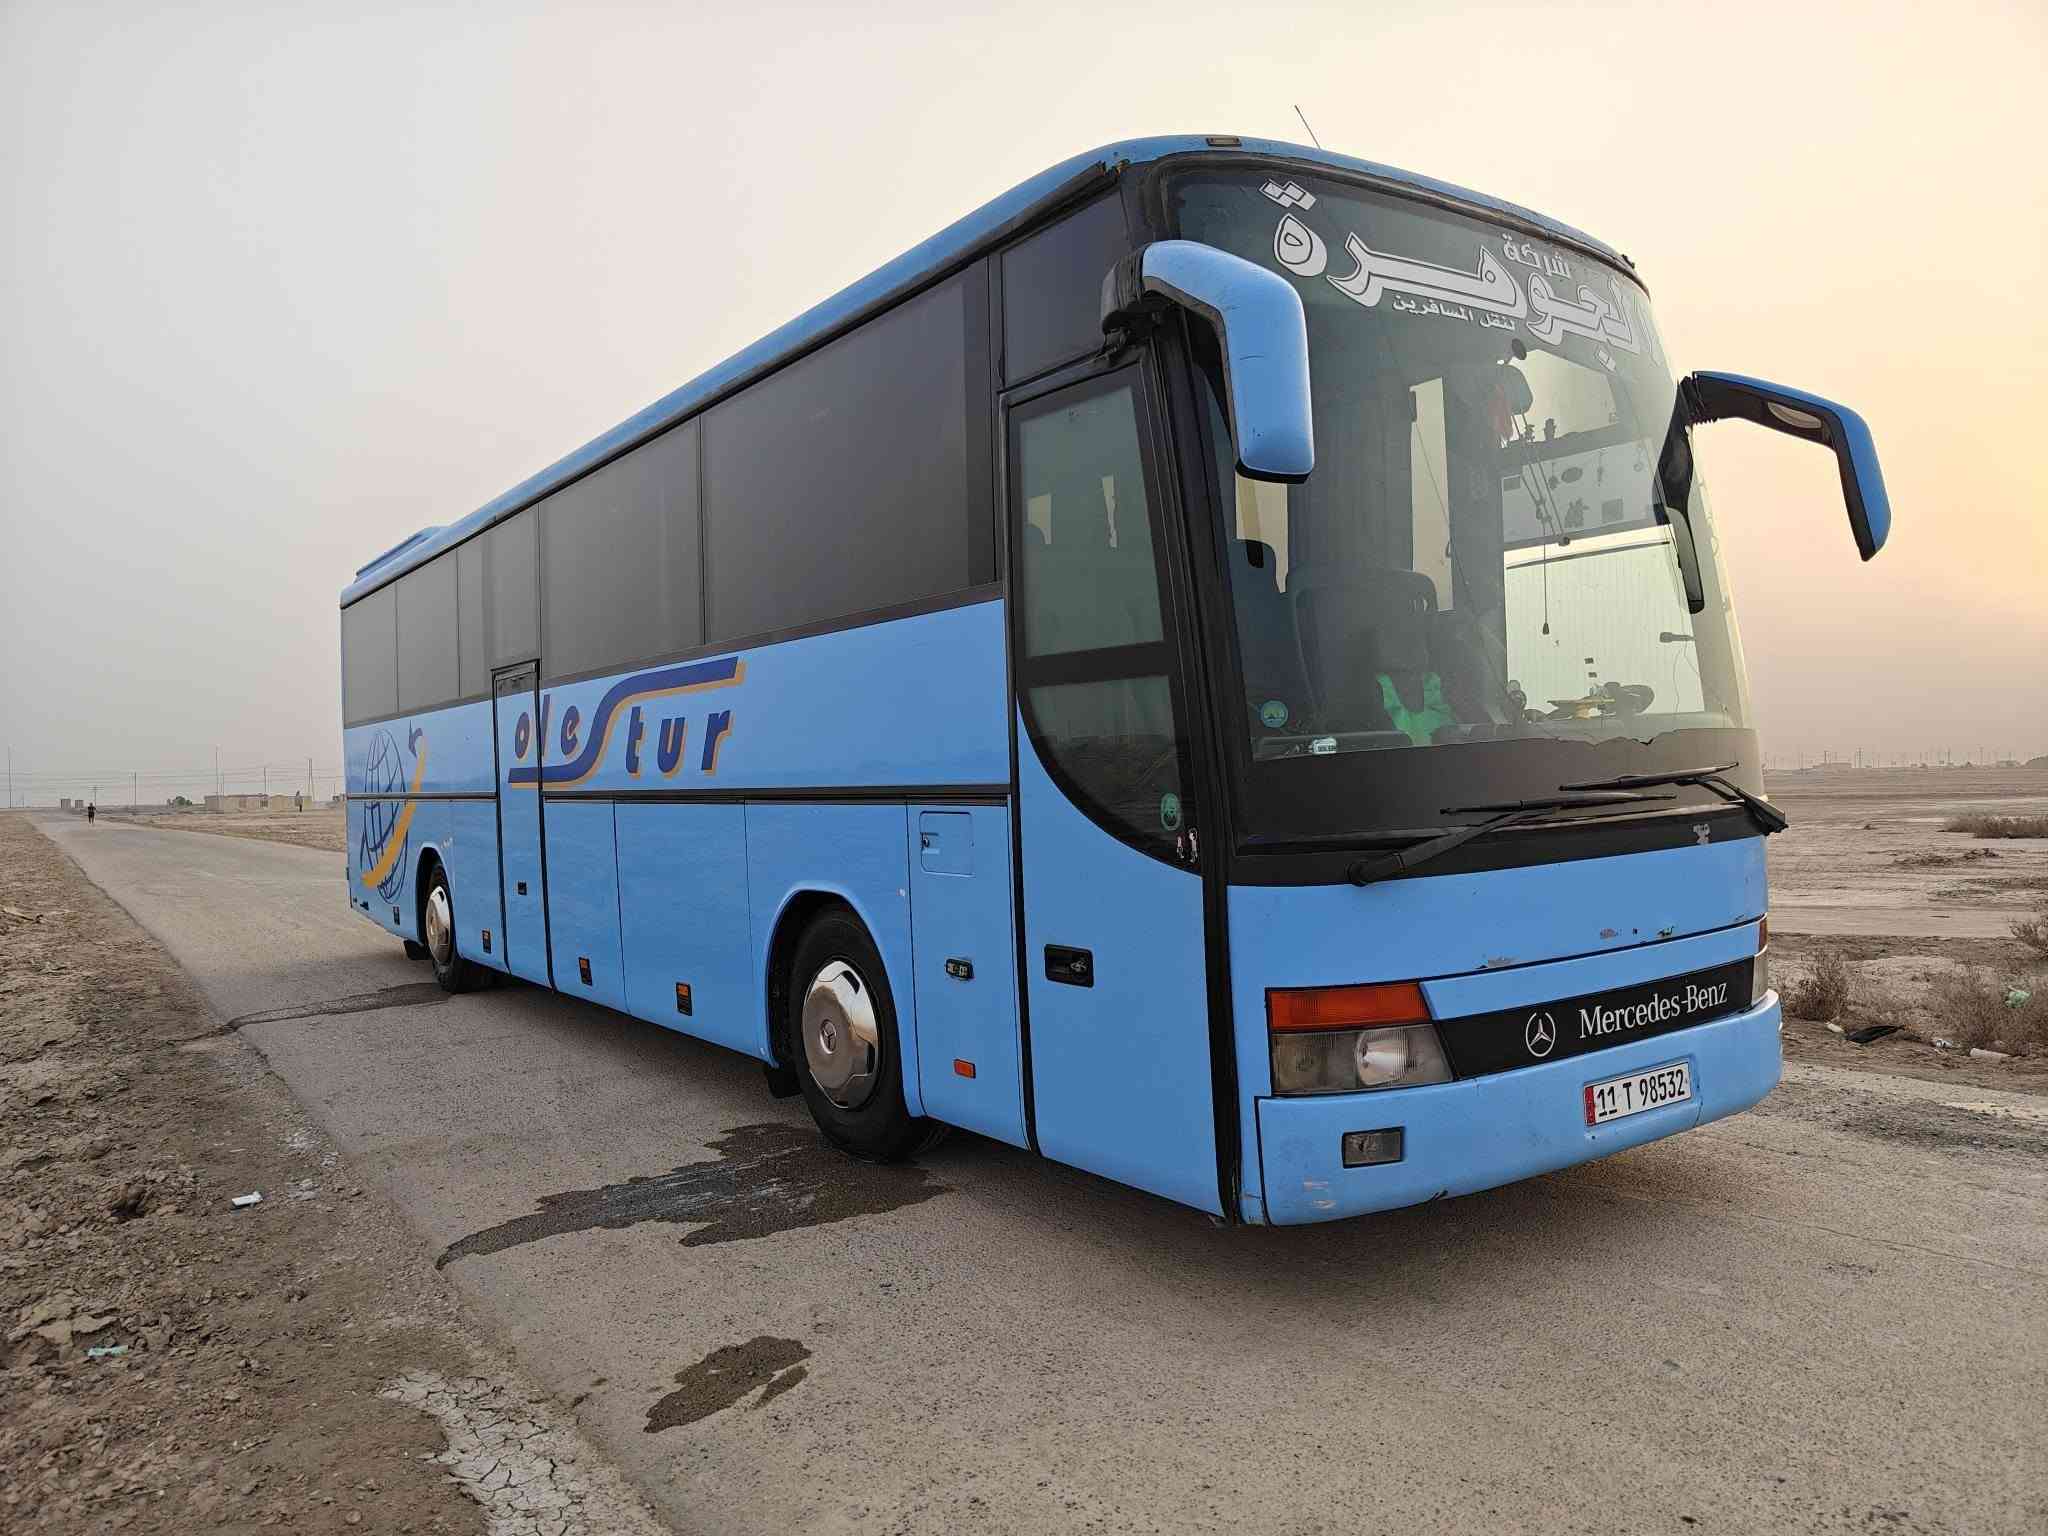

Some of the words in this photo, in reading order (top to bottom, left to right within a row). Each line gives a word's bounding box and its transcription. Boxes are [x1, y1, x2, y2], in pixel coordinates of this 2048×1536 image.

[1503, 234, 1571, 279] شركة
[1579, 982, 1728, 1038] Mercedes-Benz
[1640, 1069, 1685, 1106] 98532
